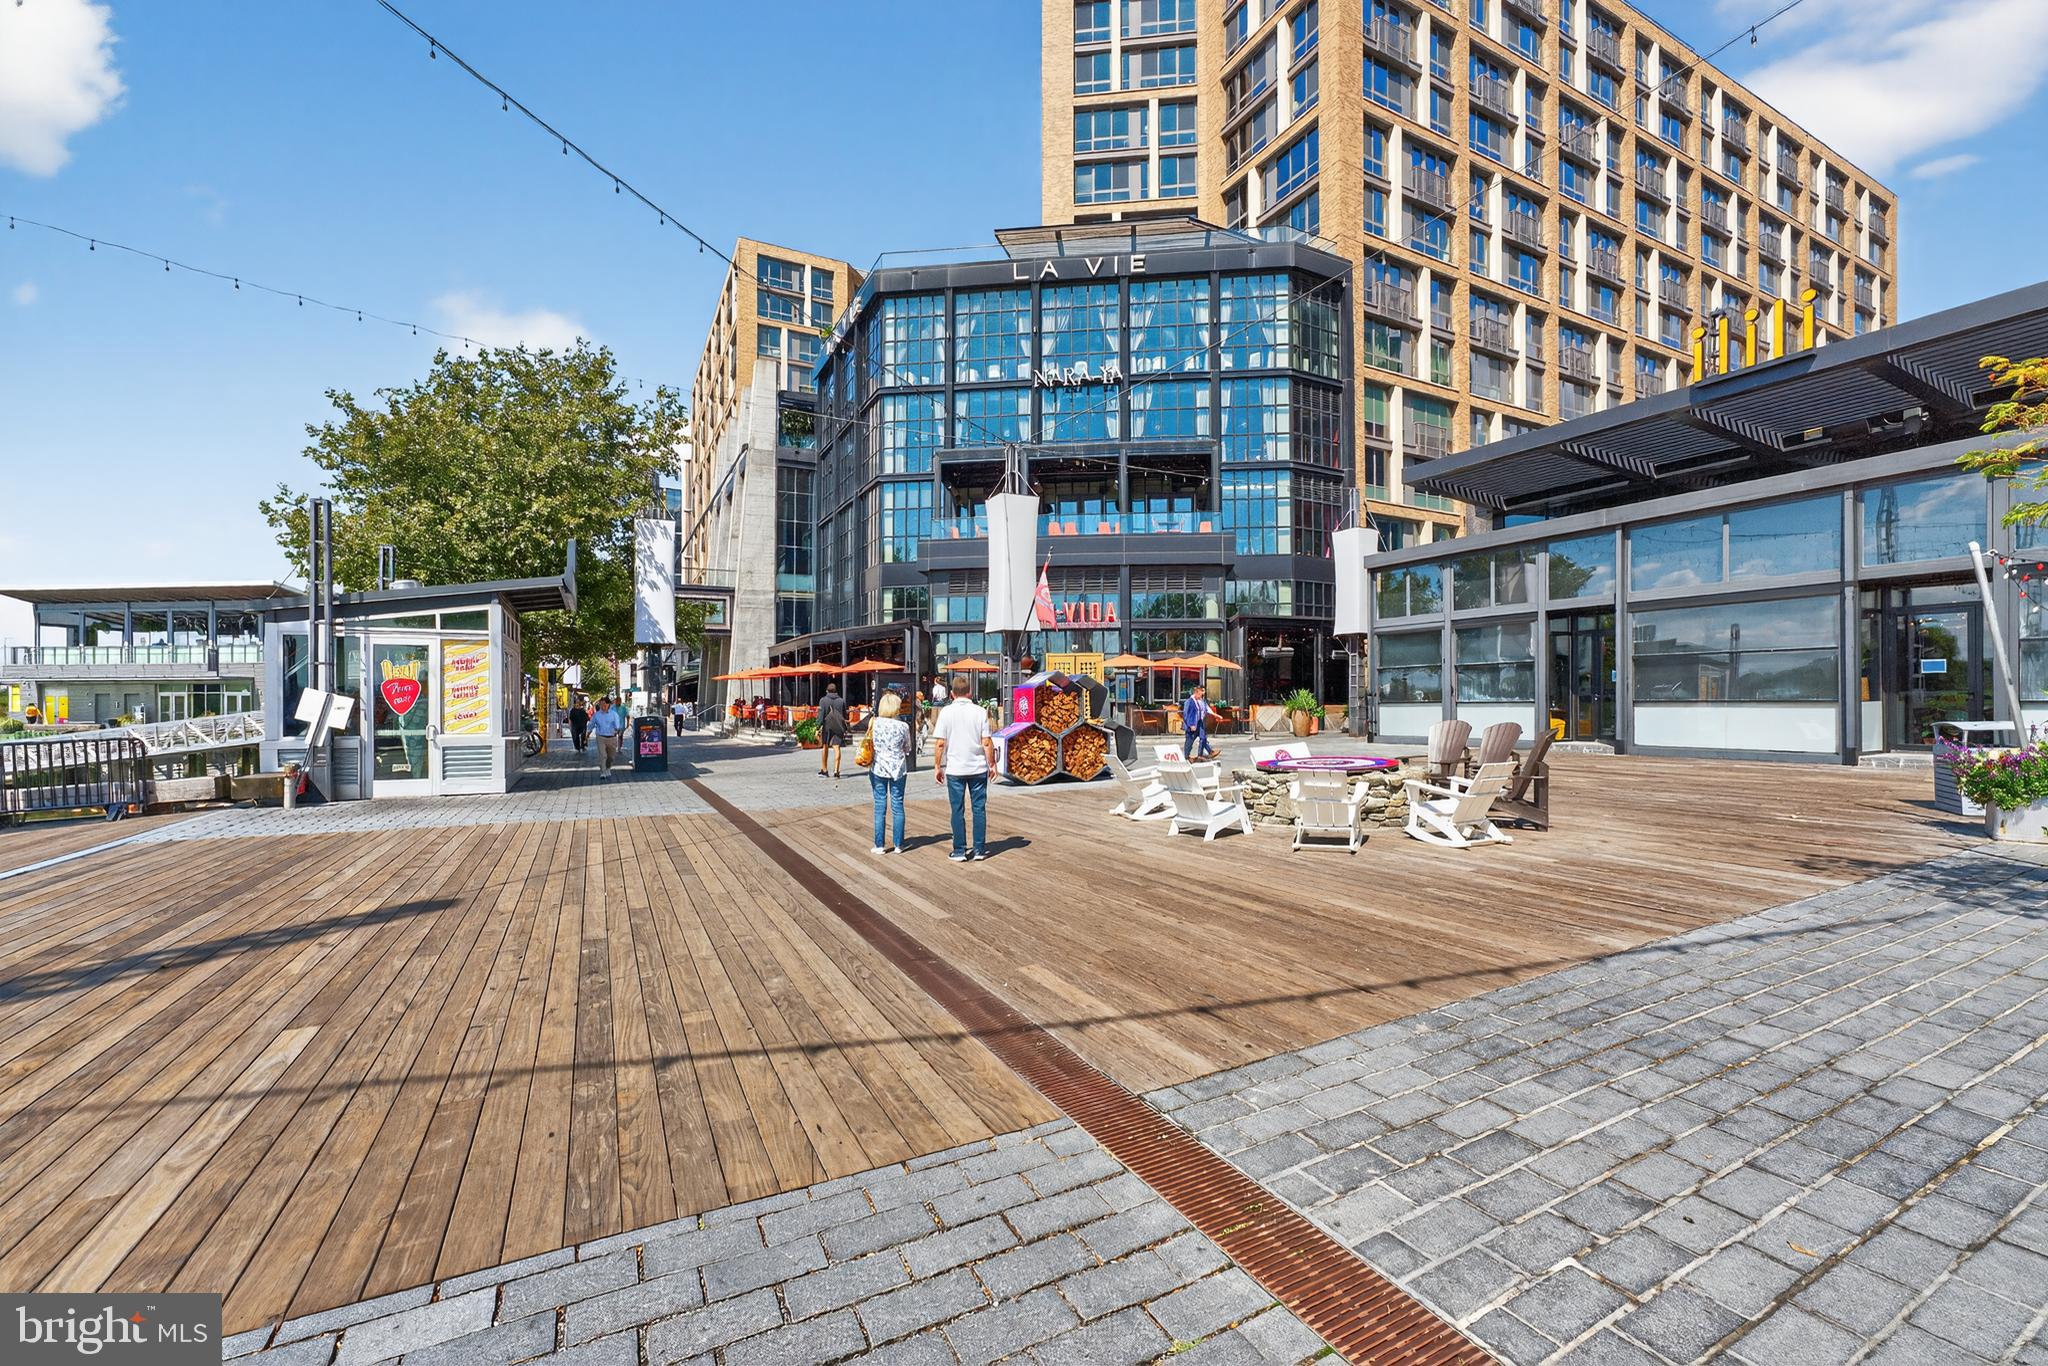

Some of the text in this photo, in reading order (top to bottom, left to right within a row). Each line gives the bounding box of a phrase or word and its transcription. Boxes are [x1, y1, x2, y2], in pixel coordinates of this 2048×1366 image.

[1013, 254, 1146, 280] LA VIE
[1063, 601, 1117, 623] VIDA
